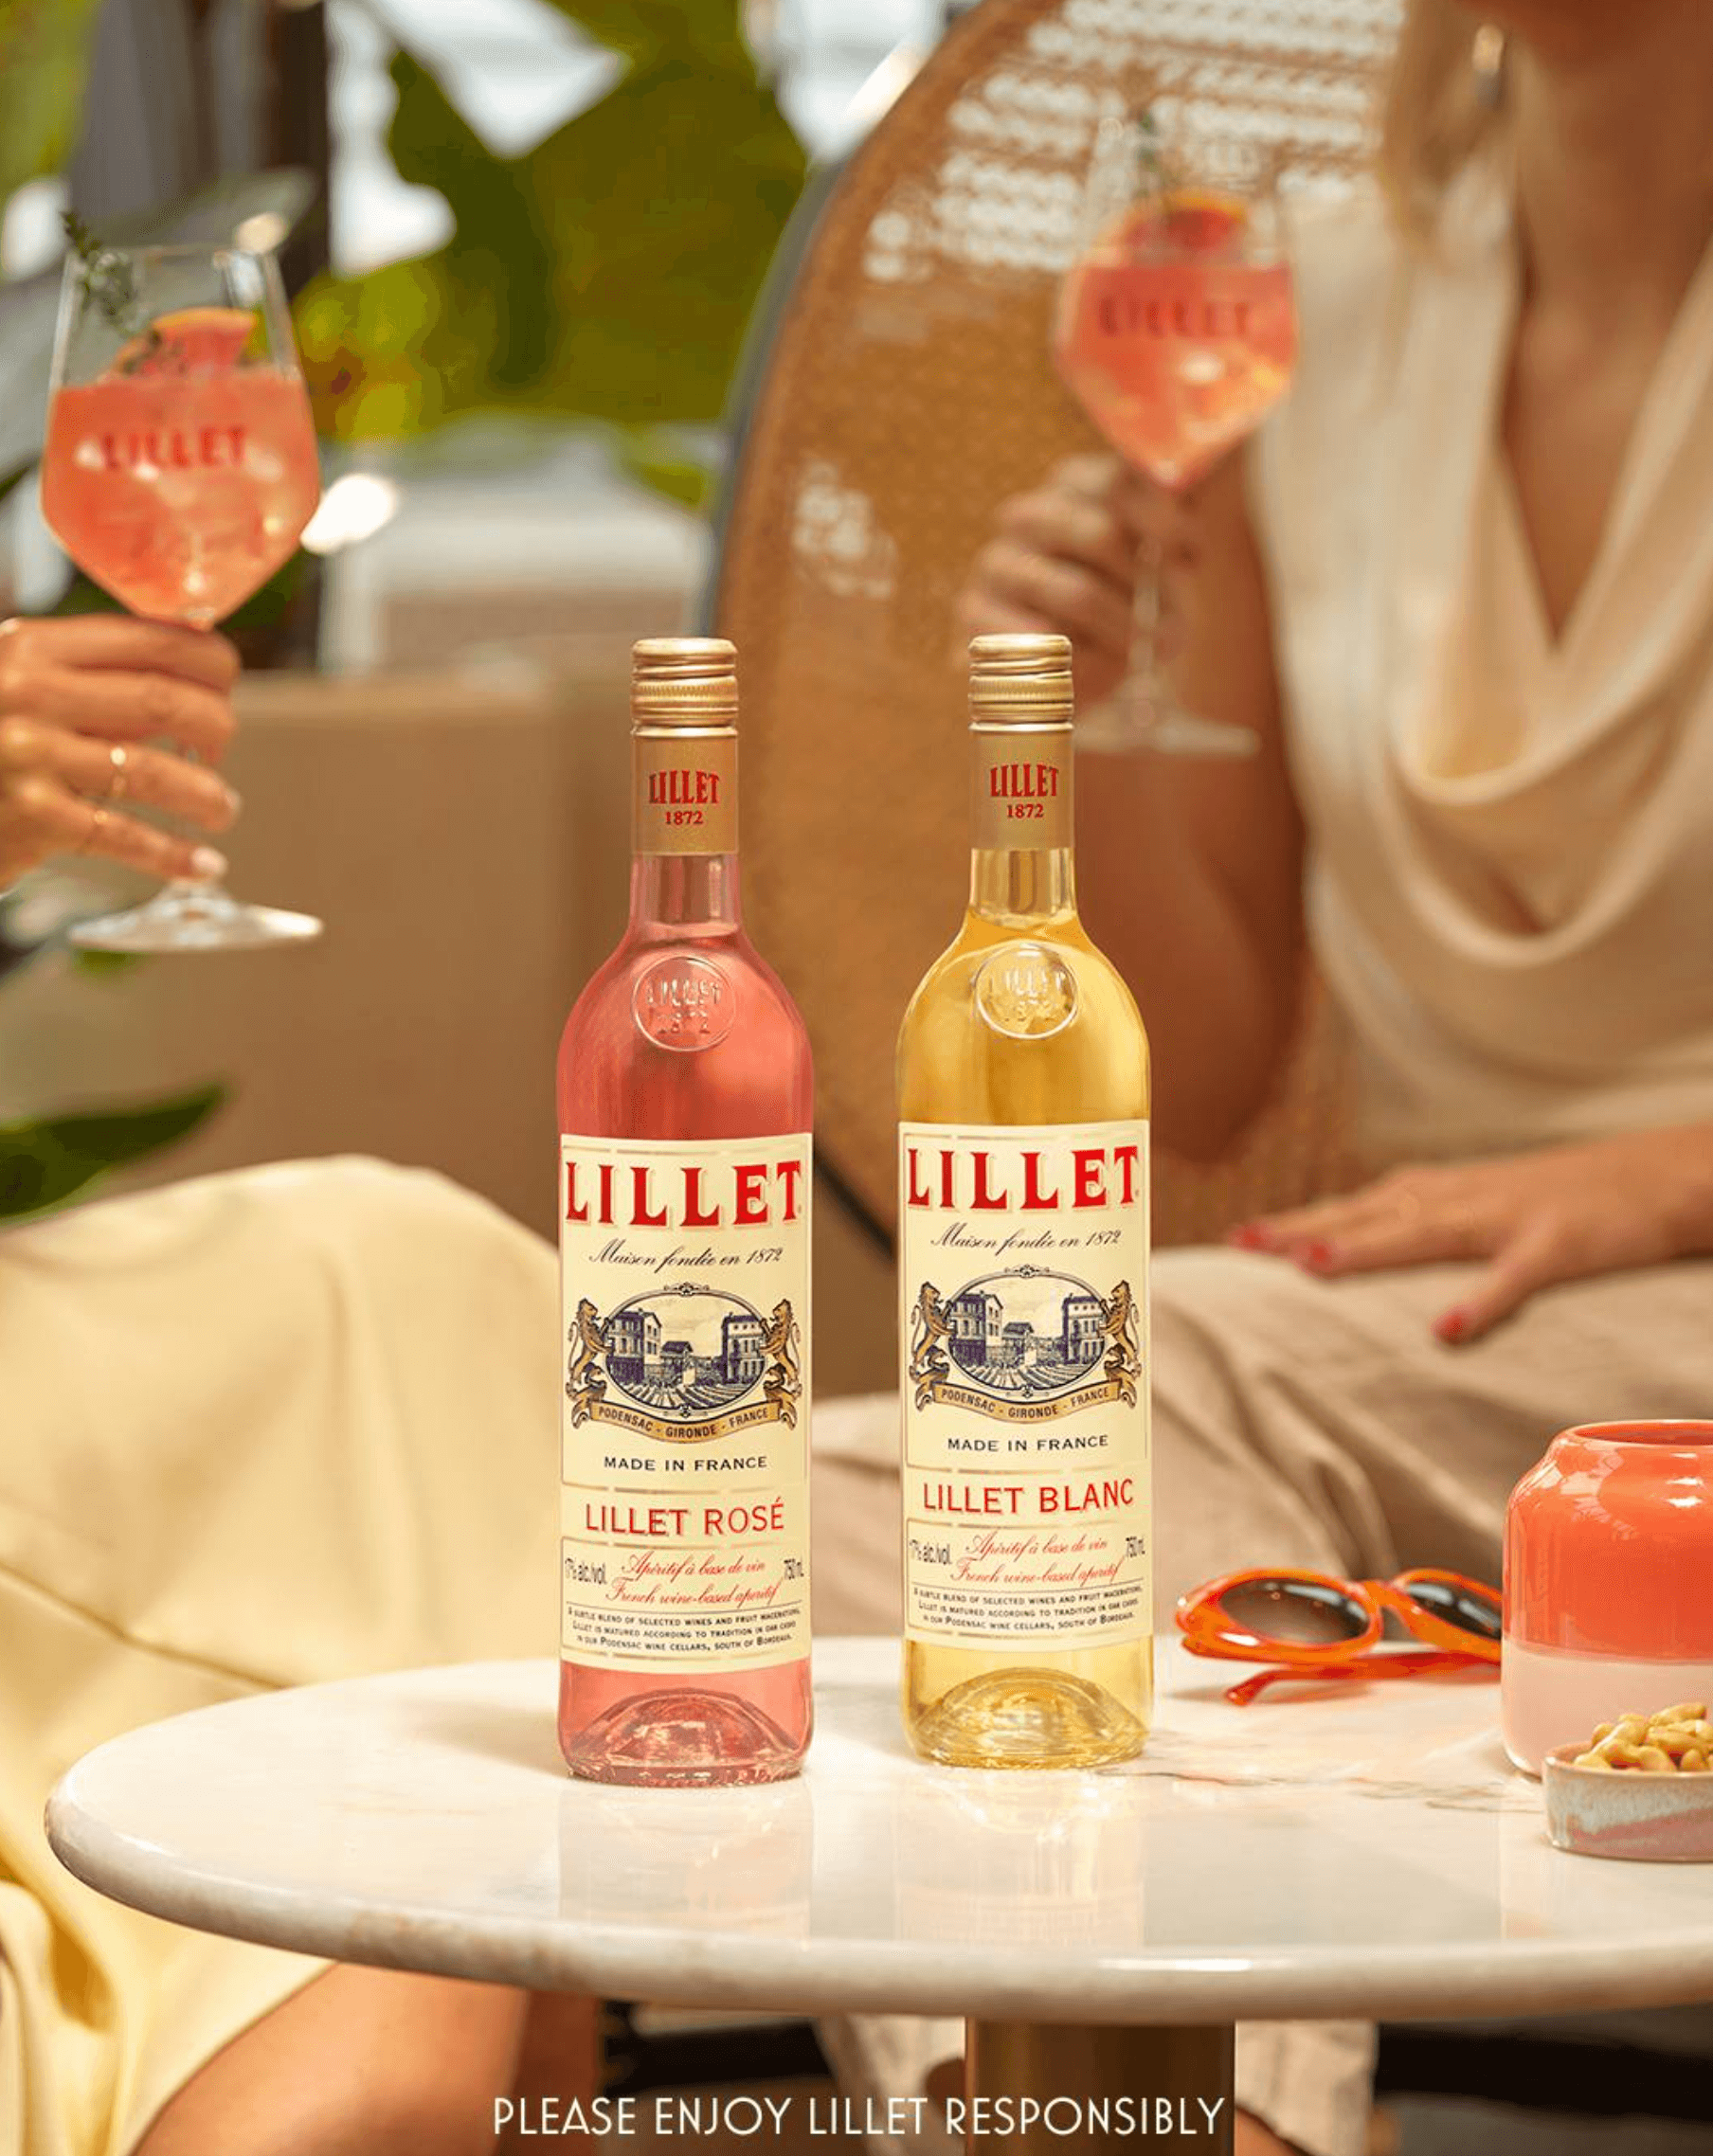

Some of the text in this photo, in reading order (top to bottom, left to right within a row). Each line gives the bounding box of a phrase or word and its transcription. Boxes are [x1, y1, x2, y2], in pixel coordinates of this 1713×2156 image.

[102, 426, 247, 470] LILLET
[648, 770, 720, 804] LILLET
[990, 763, 1059, 798] LILLET
[664, 811, 703, 825] 1872
[1006, 803, 1044, 818] 1872
[908, 1145, 1138, 1210] LILLET
[566, 1159, 801, 1227] LILLET
[930, 1222, 997, 1249] Maison
[1058, 1238, 1079, 1248] en
[1086, 1229, 1122, 1247] 1872
[589, 1237, 656, 1265] Maison
[719, 1256, 739, 1266] en
[746, 1248, 783, 1264] 1872
[941, 1388, 996, 1413] PODENSAC
[1008, 1405, 1058, 1419] GIRONDE
[1071, 1387, 1109, 1408] FRANCE
[599, 1406, 653, 1431] PODENSAC
[665, 1425, 717, 1438] GIRONDE
[729, 1407, 768, 1428] FRANCE
[947, 1435, 1109, 1452] MADE IN FRANCE
[604, 1456, 767, 1471] MADE IN FRANCE
[923, 1478, 1133, 1514] LILLET BLANC
[586, 1496, 784, 1536] LILLET ROSÉ
[1042, 1534, 1068, 1554] base
[1071, 1534, 1087, 1553] de
[1089, 1537, 1108, 1551] vin
[699, 1554, 726, 1575] base
[728, 1554, 744, 1573] de
[746, 1559, 766, 1572] vin
[950, 1556, 1005, 1582] French
[605, 1576, 661, 1603] French
[1059, 1595, 1076, 1604] AND
[639, 1618, 681, 1626] SELECTED
[643, 1630, 692, 1639] ACCORDING
